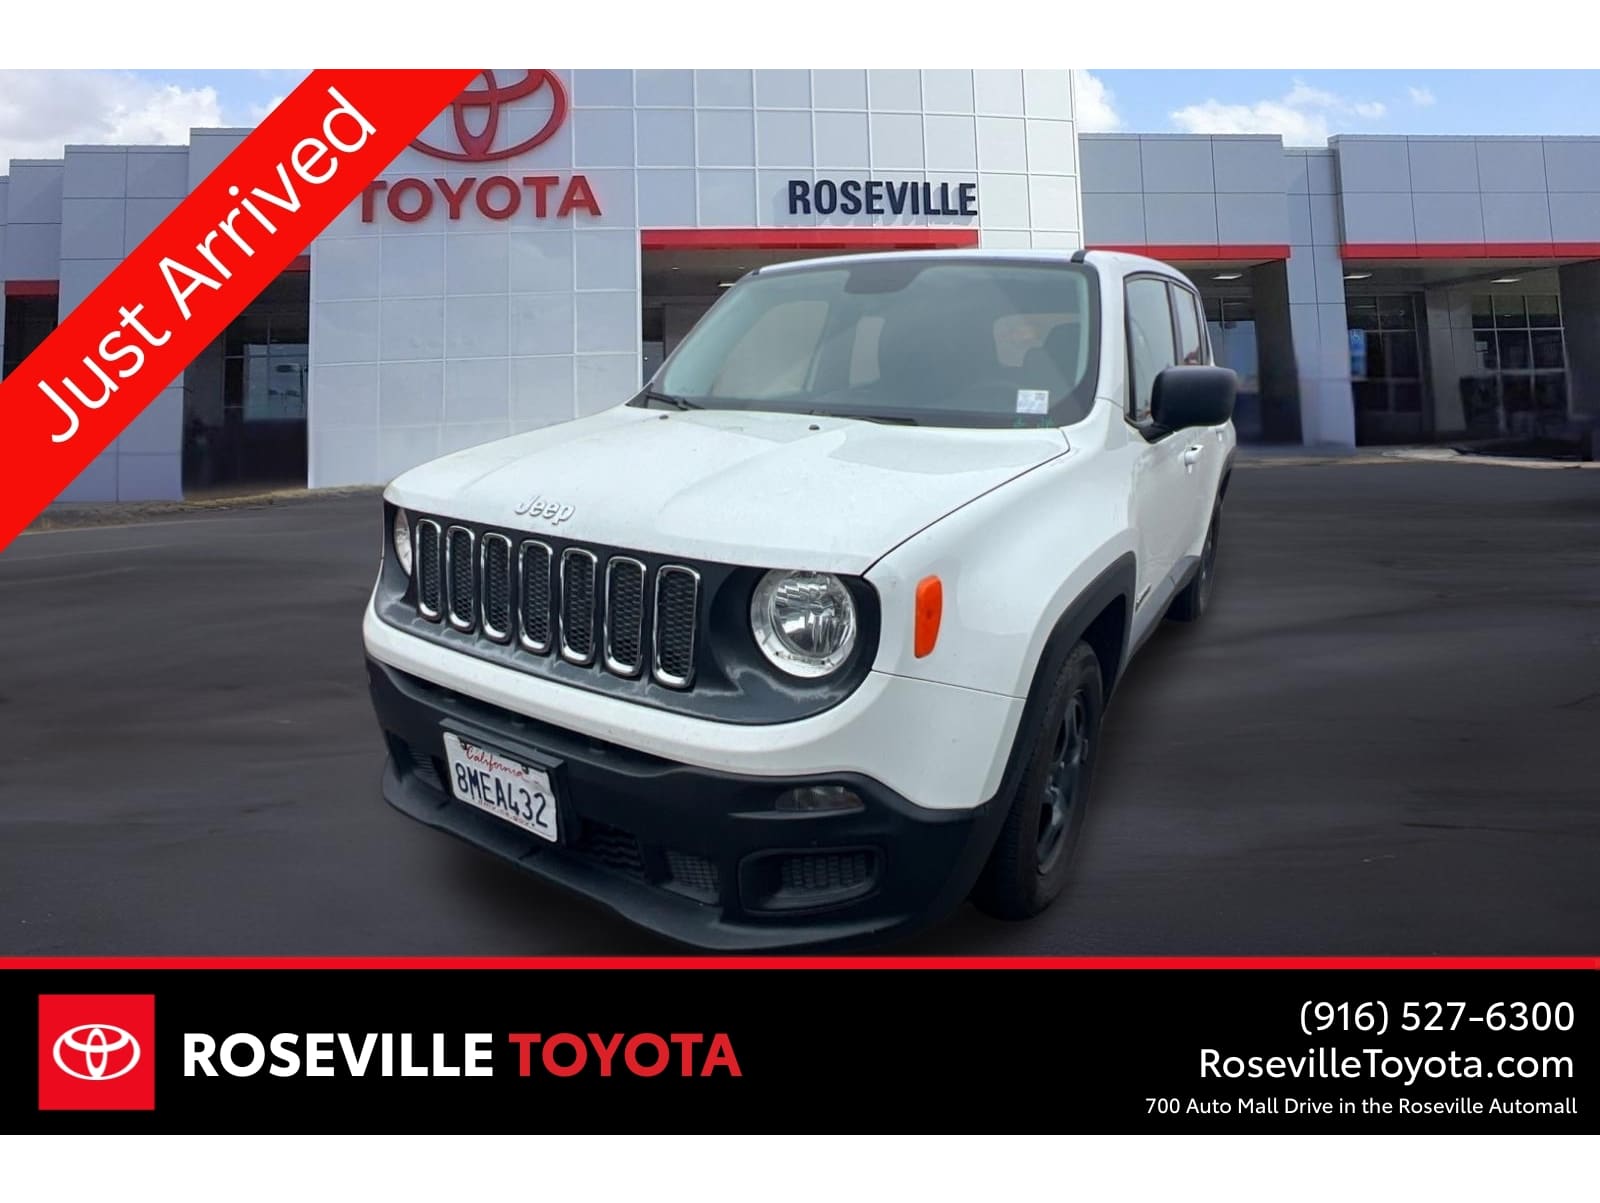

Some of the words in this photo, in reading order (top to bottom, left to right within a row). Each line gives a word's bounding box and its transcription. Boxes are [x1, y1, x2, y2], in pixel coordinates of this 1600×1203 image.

[361, 175, 602, 222] TOYOTA
[788, 180, 978, 216] ROSEVILLE
[513, 495, 576, 526] Jeep
[465, 746, 525, 778] California
[455, 762, 549, 829] 8MEA432
